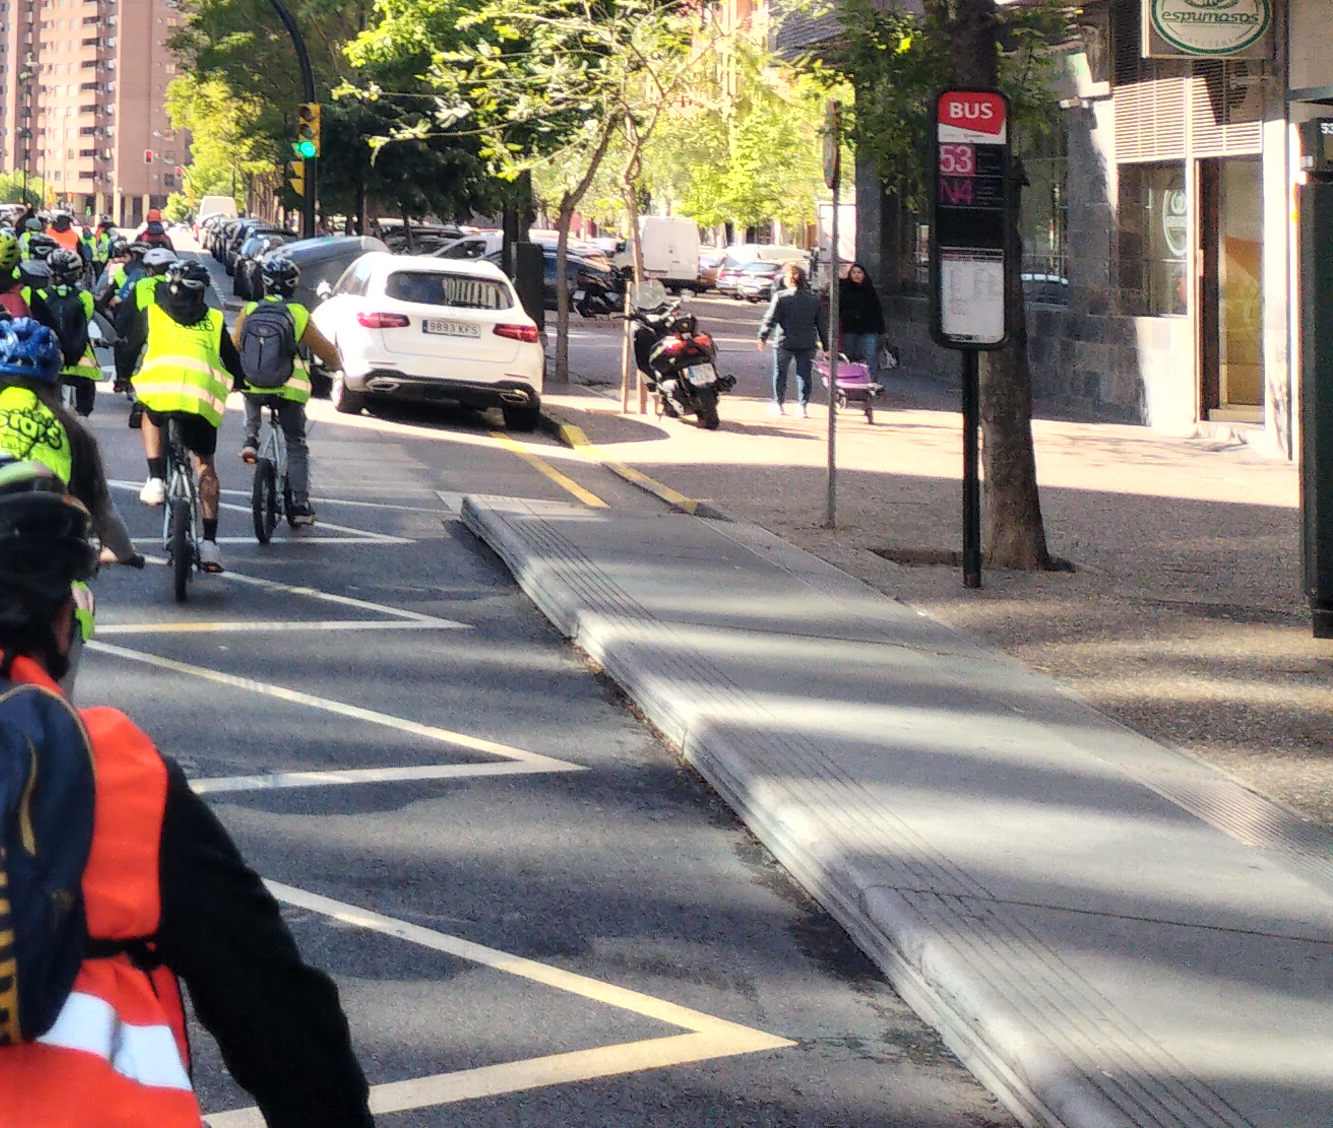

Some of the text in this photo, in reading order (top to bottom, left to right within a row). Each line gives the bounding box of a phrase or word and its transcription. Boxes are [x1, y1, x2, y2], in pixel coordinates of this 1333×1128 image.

[949, 101, 993, 120] BUS
[939, 145, 972, 173] 53
[939, 180, 973, 205] N4
